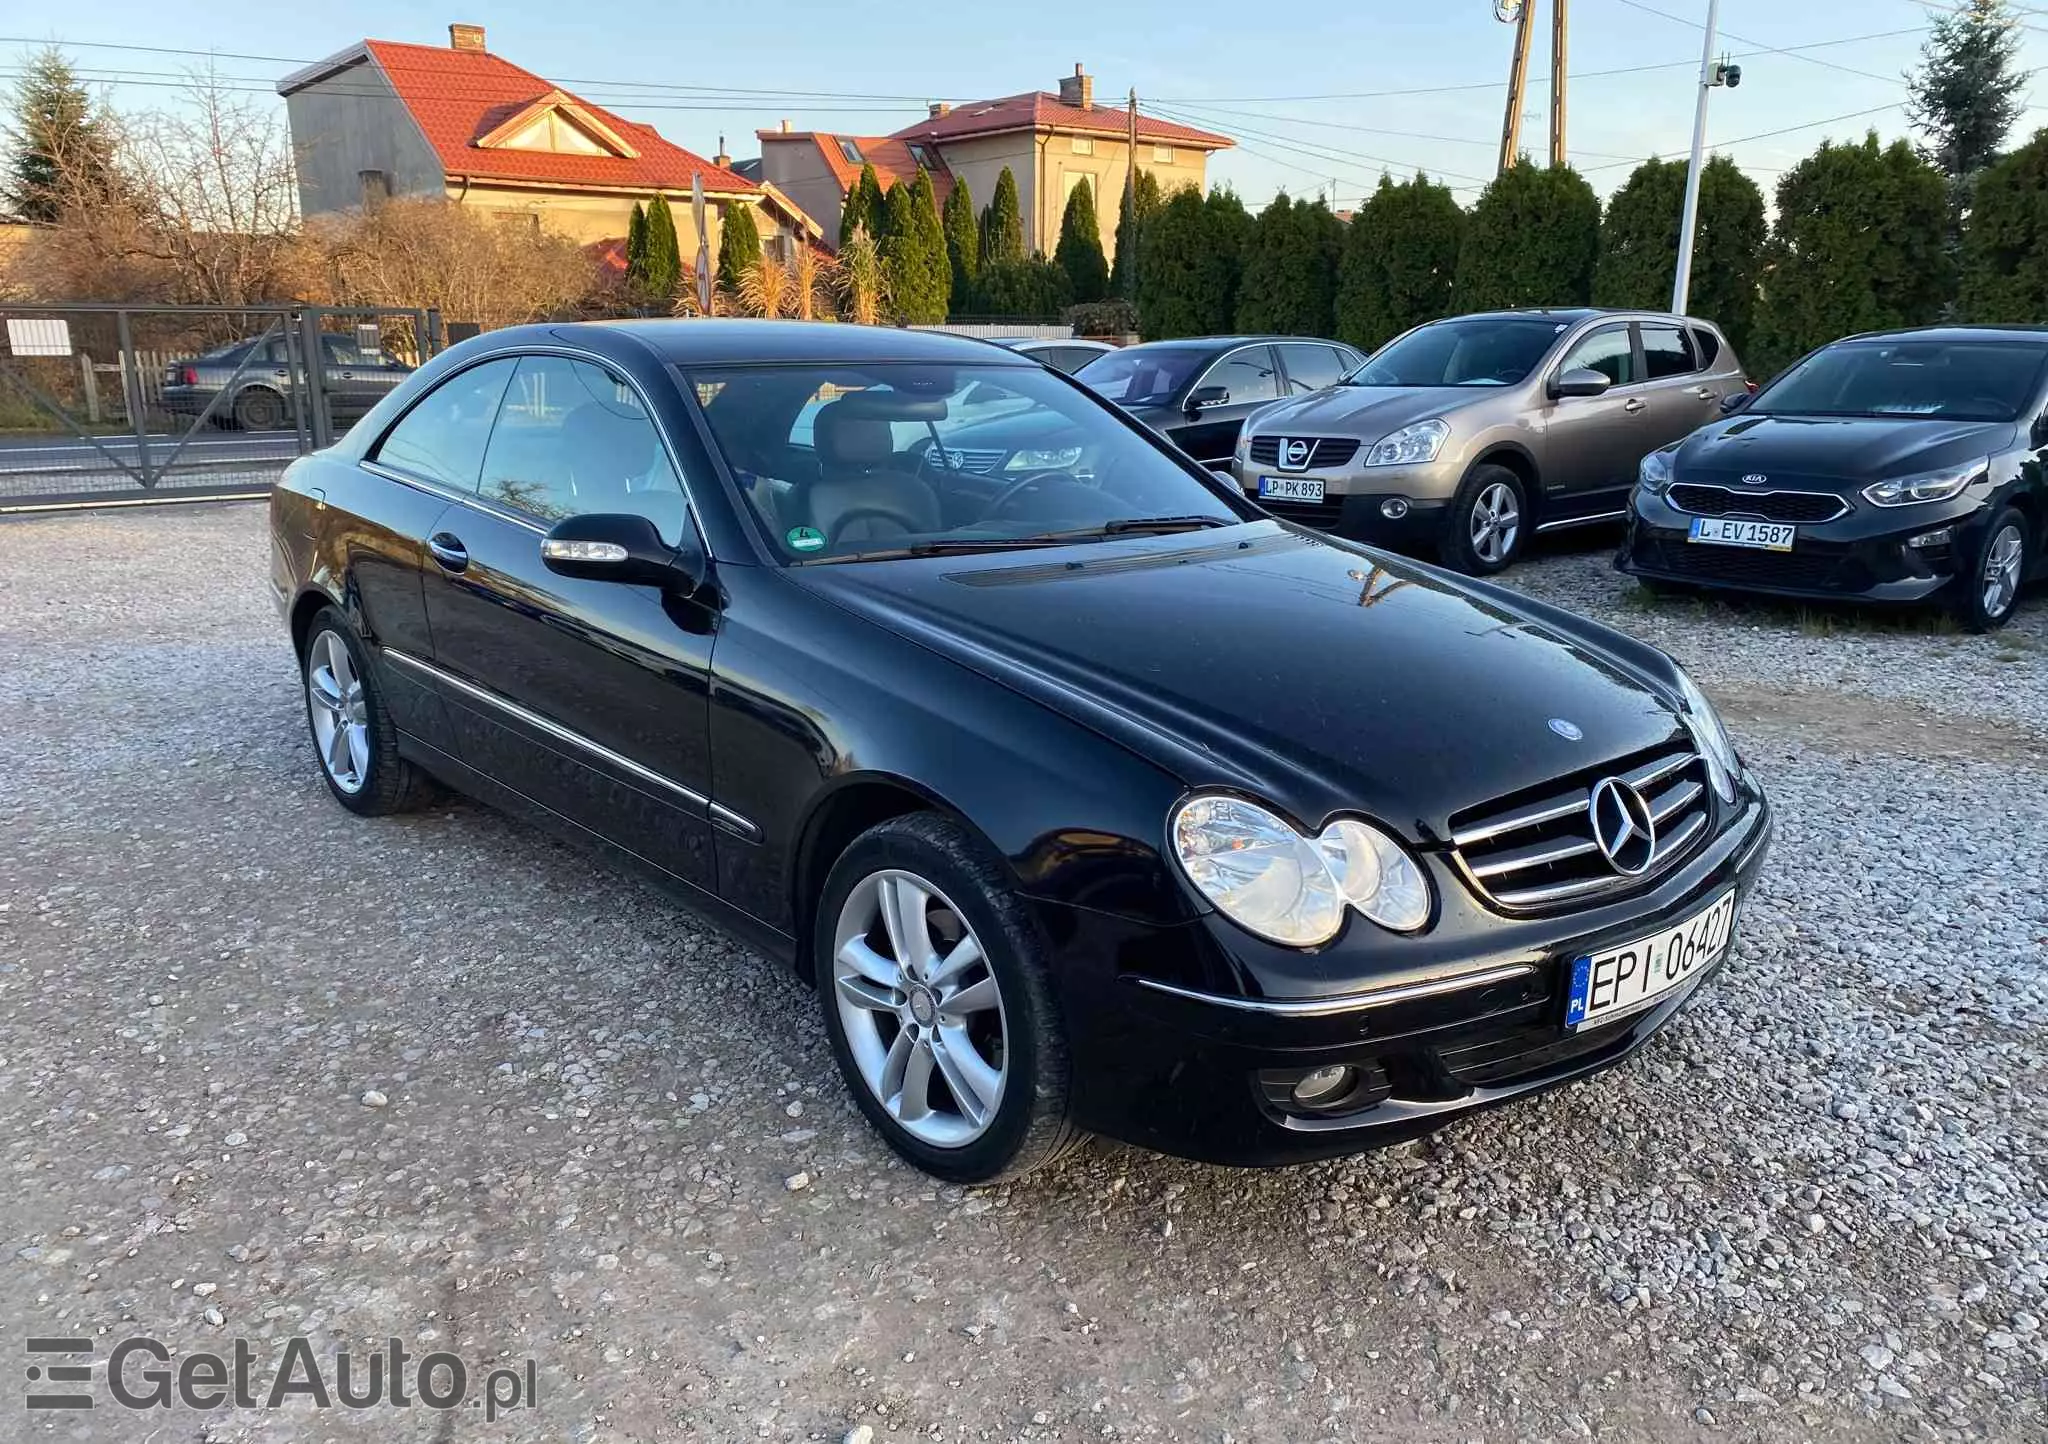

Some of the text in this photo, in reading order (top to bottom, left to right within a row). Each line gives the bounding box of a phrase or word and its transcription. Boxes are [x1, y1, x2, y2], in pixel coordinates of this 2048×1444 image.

[1265, 480, 1322, 497] LP PK 893
[1700, 520, 1793, 545] L EV 1587
[1589, 944, 1653, 1012] EPI
[1665, 896, 1732, 980] 06427
[1570, 998, 1584, 1014] PL
